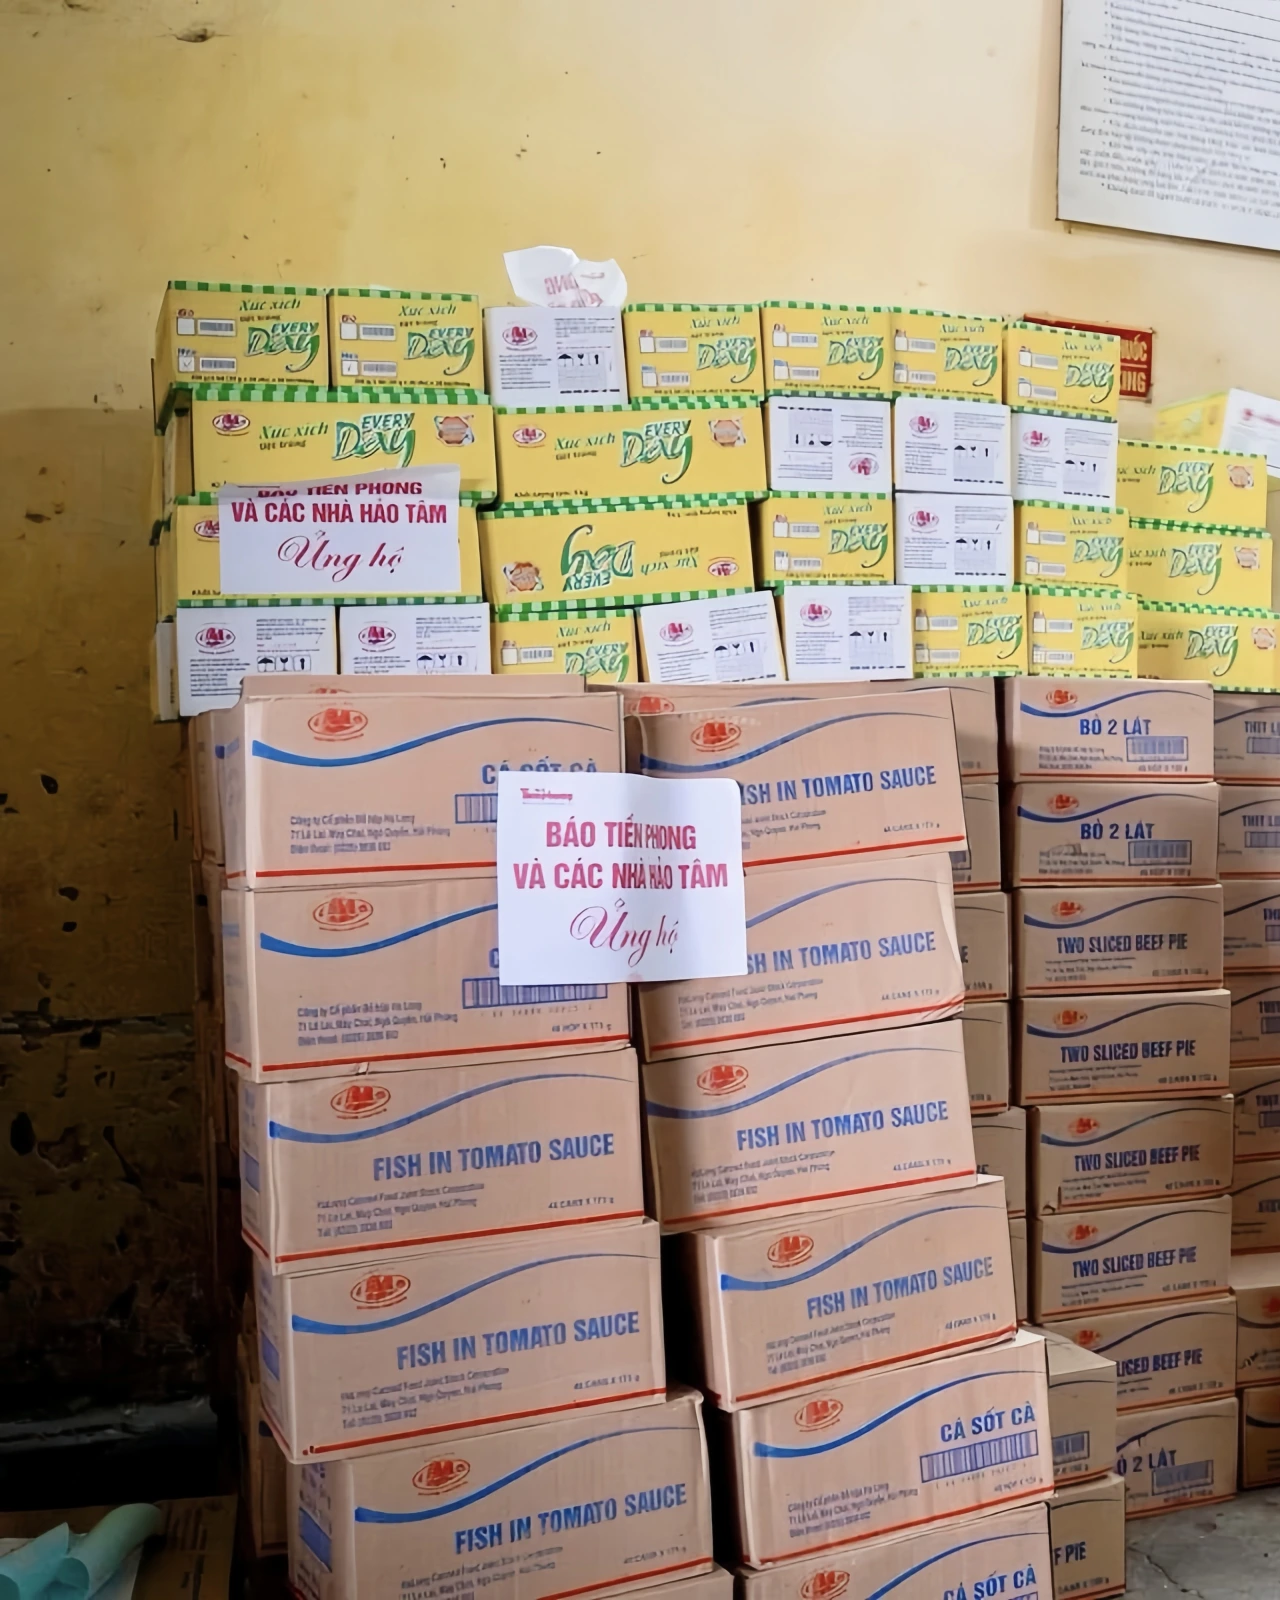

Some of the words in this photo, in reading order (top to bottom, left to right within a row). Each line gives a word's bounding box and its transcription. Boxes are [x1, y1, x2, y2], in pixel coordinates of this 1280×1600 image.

[271, 322, 319, 334] EVERY
[429, 327, 473, 339] EVERY
[244, 327, 320, 373] Day
[404, 332, 475, 375] Day
[362, 413, 415, 429] EVERY
[645, 420, 691, 436] EVERY
[356, 482, 422, 495] PHONG
[232, 498, 257, 522] VÀ
[265, 499, 305, 522] CÁC
[313, 499, 353, 523] NHÀ
[406, 501, 447, 523] TÂM
[1080, 714, 1101, 735] BÒ
[1108, 719, 1117, 735] 2
[741, 782, 771, 806] ISH
[777, 780, 798, 802] IN
[802, 772, 873, 799] TOMATO
[880, 765, 937, 790] SAUCE
[546, 815, 596, 847] BÁO
[646, 823, 697, 850] PHONG
[1081, 818, 1103, 840] BÒ
[1110, 824, 1120, 839] 2
[513, 857, 546, 889] VÀ
[554, 857, 603, 889] CÁC
[612, 857, 647, 889] NHÀ
[678, 858, 728, 889] TÂM
[570, 898, 651, 967] Ủng
[1057, 936, 1084, 954] TWO
[1089, 934, 1131, 954] SLICED
[1135, 933, 1165, 951] BEEF
[1169, 933, 1188, 950] PIE
[748, 952, 767, 975] SH
[774, 949, 794, 971] IN
[798, 940, 872, 968] TOMATO
[878, 931, 936, 958] SAUCE
[1061, 1045, 1088, 1063] TWO
[1093, 1042, 1138, 1062] SLICED
[1142, 1040, 1173, 1059] BEEF
[1176, 1039, 1196, 1057] PIE
[737, 1125, 779, 1151] FISH
[786, 1121, 806, 1143] IN
[812, 1110, 884, 1139] TOMATO
[892, 1100, 948, 1128] SAUCE
[373, 1151, 422, 1181] FISH
[430, 1149, 452, 1174] IN
[459, 1140, 541, 1172] TOMATO
[548, 1133, 614, 1161] SAUCE
[1075, 1153, 1101, 1172] TWO
[1105, 1149, 1147, 1169] SLICED
[1150, 1146, 1179, 1165] BEEF
[1072, 1259, 1099, 1278] TWO
[1102, 1254, 1144, 1275] SLICED
[807, 1290, 845, 1319] FISH
[851, 1286, 869, 1309] IN
[872, 1270, 937, 1302] TOMATO
[944, 1257, 994, 1286] SAUCE
[397, 1339, 446, 1370] FISH
[454, 1335, 476, 1360] IN
[483, 1323, 567, 1357] TOMATO
[574, 1311, 640, 1342] SAUCE
[1117, 1357, 1150, 1378] LICED
[1152, 1352, 1181, 1372] BEEF
[1184, 1348, 1203, 1367] PIE
[941, 1417, 966, 1443] CÁ
[971, 1407, 1007, 1434] SỐT
[1117, 1454, 1127, 1476] Ò
[1132, 1452, 1143, 1473] 2
[455, 1523, 504, 1555] FISH
[510, 1518, 532, 1544] IN
[539, 1502, 617, 1536] TOMATO
[624, 1483, 686, 1517] SAUCE
[1065, 1541, 1086, 1563] PIE
[974, 1572, 1011, 1600] SỐT
